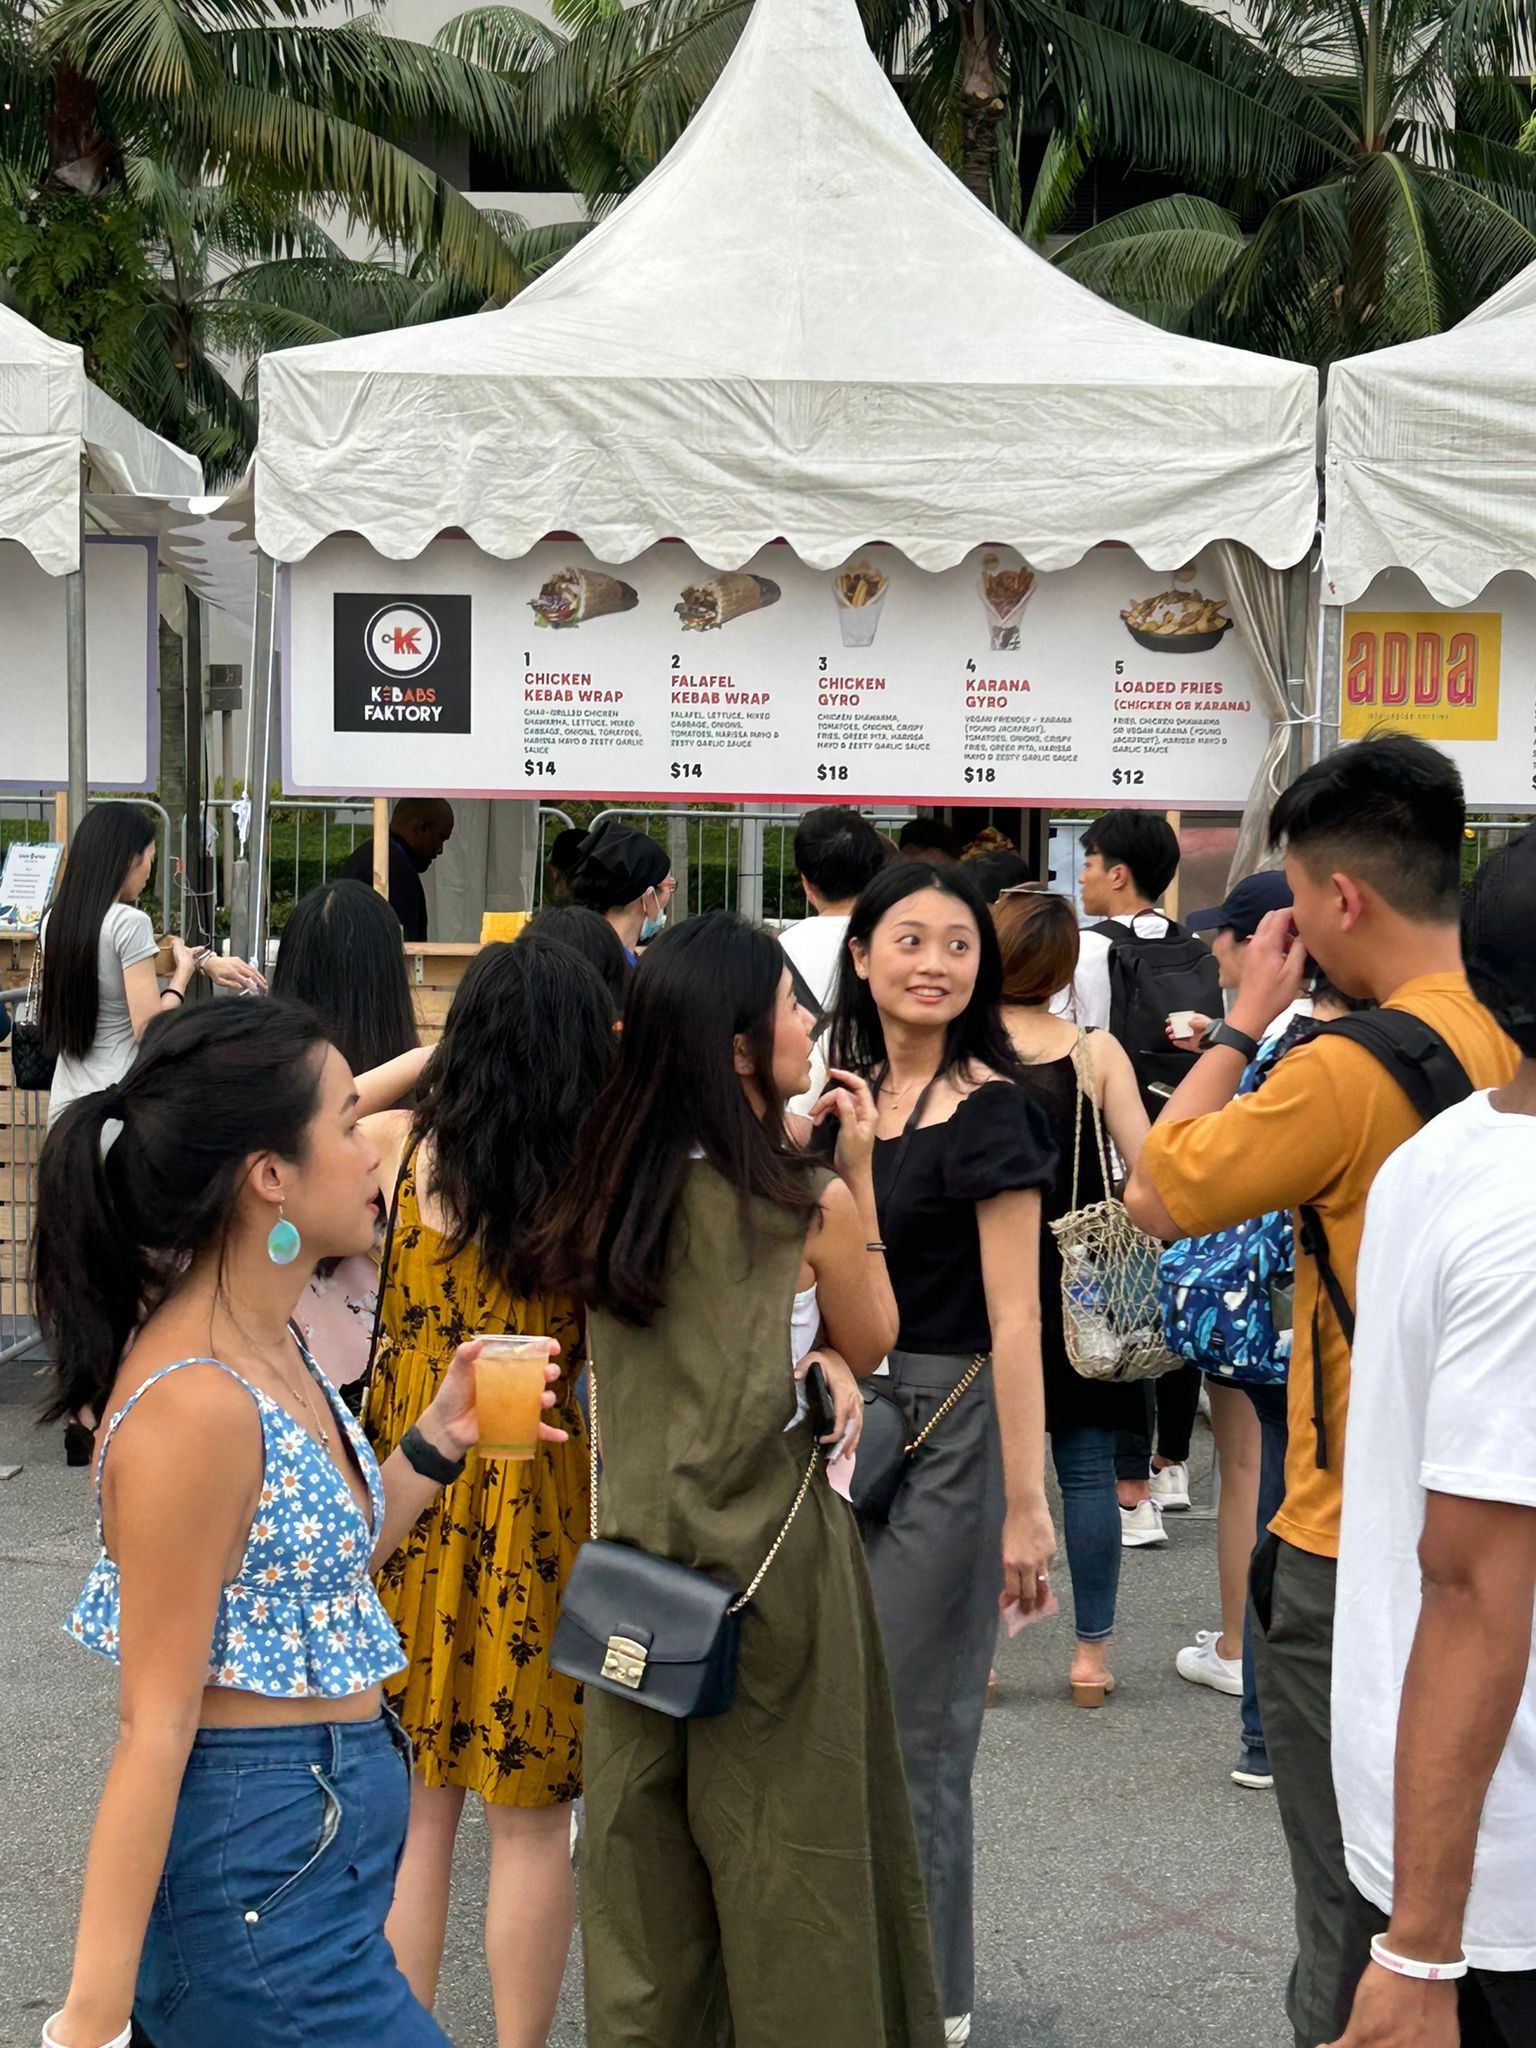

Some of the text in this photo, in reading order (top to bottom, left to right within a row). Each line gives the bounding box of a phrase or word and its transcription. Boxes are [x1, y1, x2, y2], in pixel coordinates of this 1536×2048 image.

[524, 652, 530, 666] 1
[672, 654, 680, 669] 2
[819, 657, 827, 670] 3
[966, 659, 976, 673] 4
[1115, 660, 1124, 674] 5
[525, 673, 591, 686] CHICKEN
[672, 676, 735, 688] FALAFEL
[818, 678, 886, 690] CHICKEN
[966, 679, 1030, 692] KARANA
[371, 686, 435, 702] KEBABS
[1115, 681, 1223, 694] LOADED FRIES
[524, 689, 623, 703] KEBAB WRAP
[672, 692, 770, 705] KEBAB WRAP
[818, 694, 860, 706] GYRO
[966, 696, 1007, 708] GYRO
[1114, 699, 1251, 712] (CHICKEN OR KARANA)
[365, 705, 443, 721] FAKTORY
[525, 760, 556, 775] $14
[670, 763, 702, 778] $14
[817, 764, 848, 780] $18
[964, 767, 995, 782] $18
[1112, 769, 1144, 785] $12
